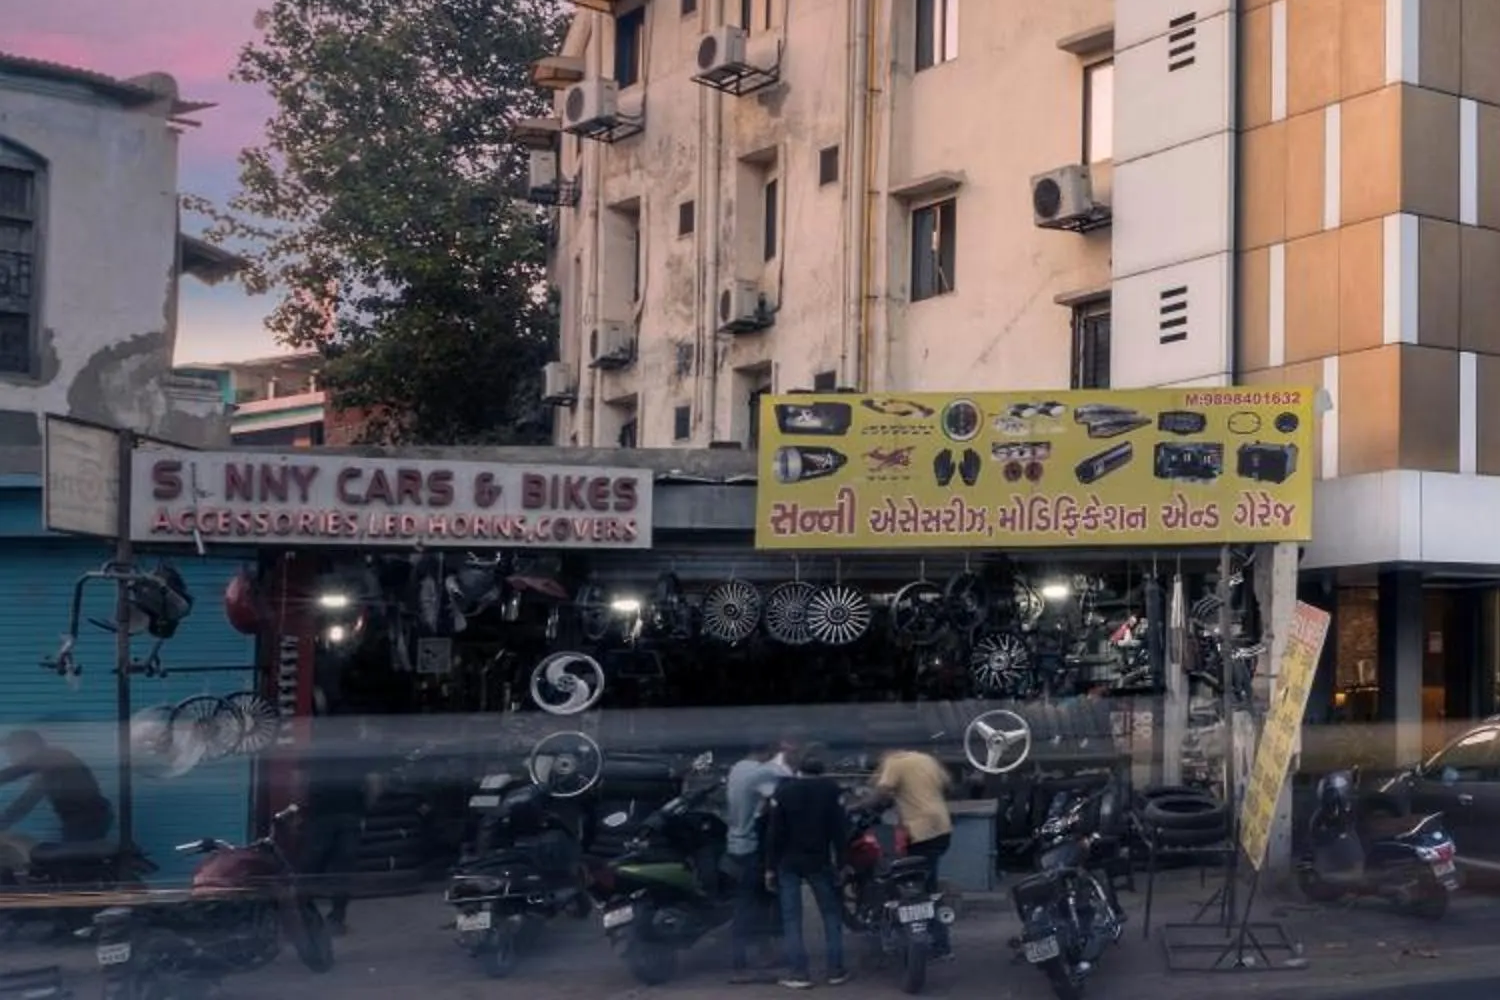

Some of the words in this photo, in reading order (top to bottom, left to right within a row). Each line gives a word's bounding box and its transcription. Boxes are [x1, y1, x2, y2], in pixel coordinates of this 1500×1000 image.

[152, 459, 320, 503] SNNY
[335, 466, 456, 507] CARS
[474, 471, 504, 509] &
[521, 472, 640, 513] BIKES
[1160, 492, 1220, 530] એન્ડ
